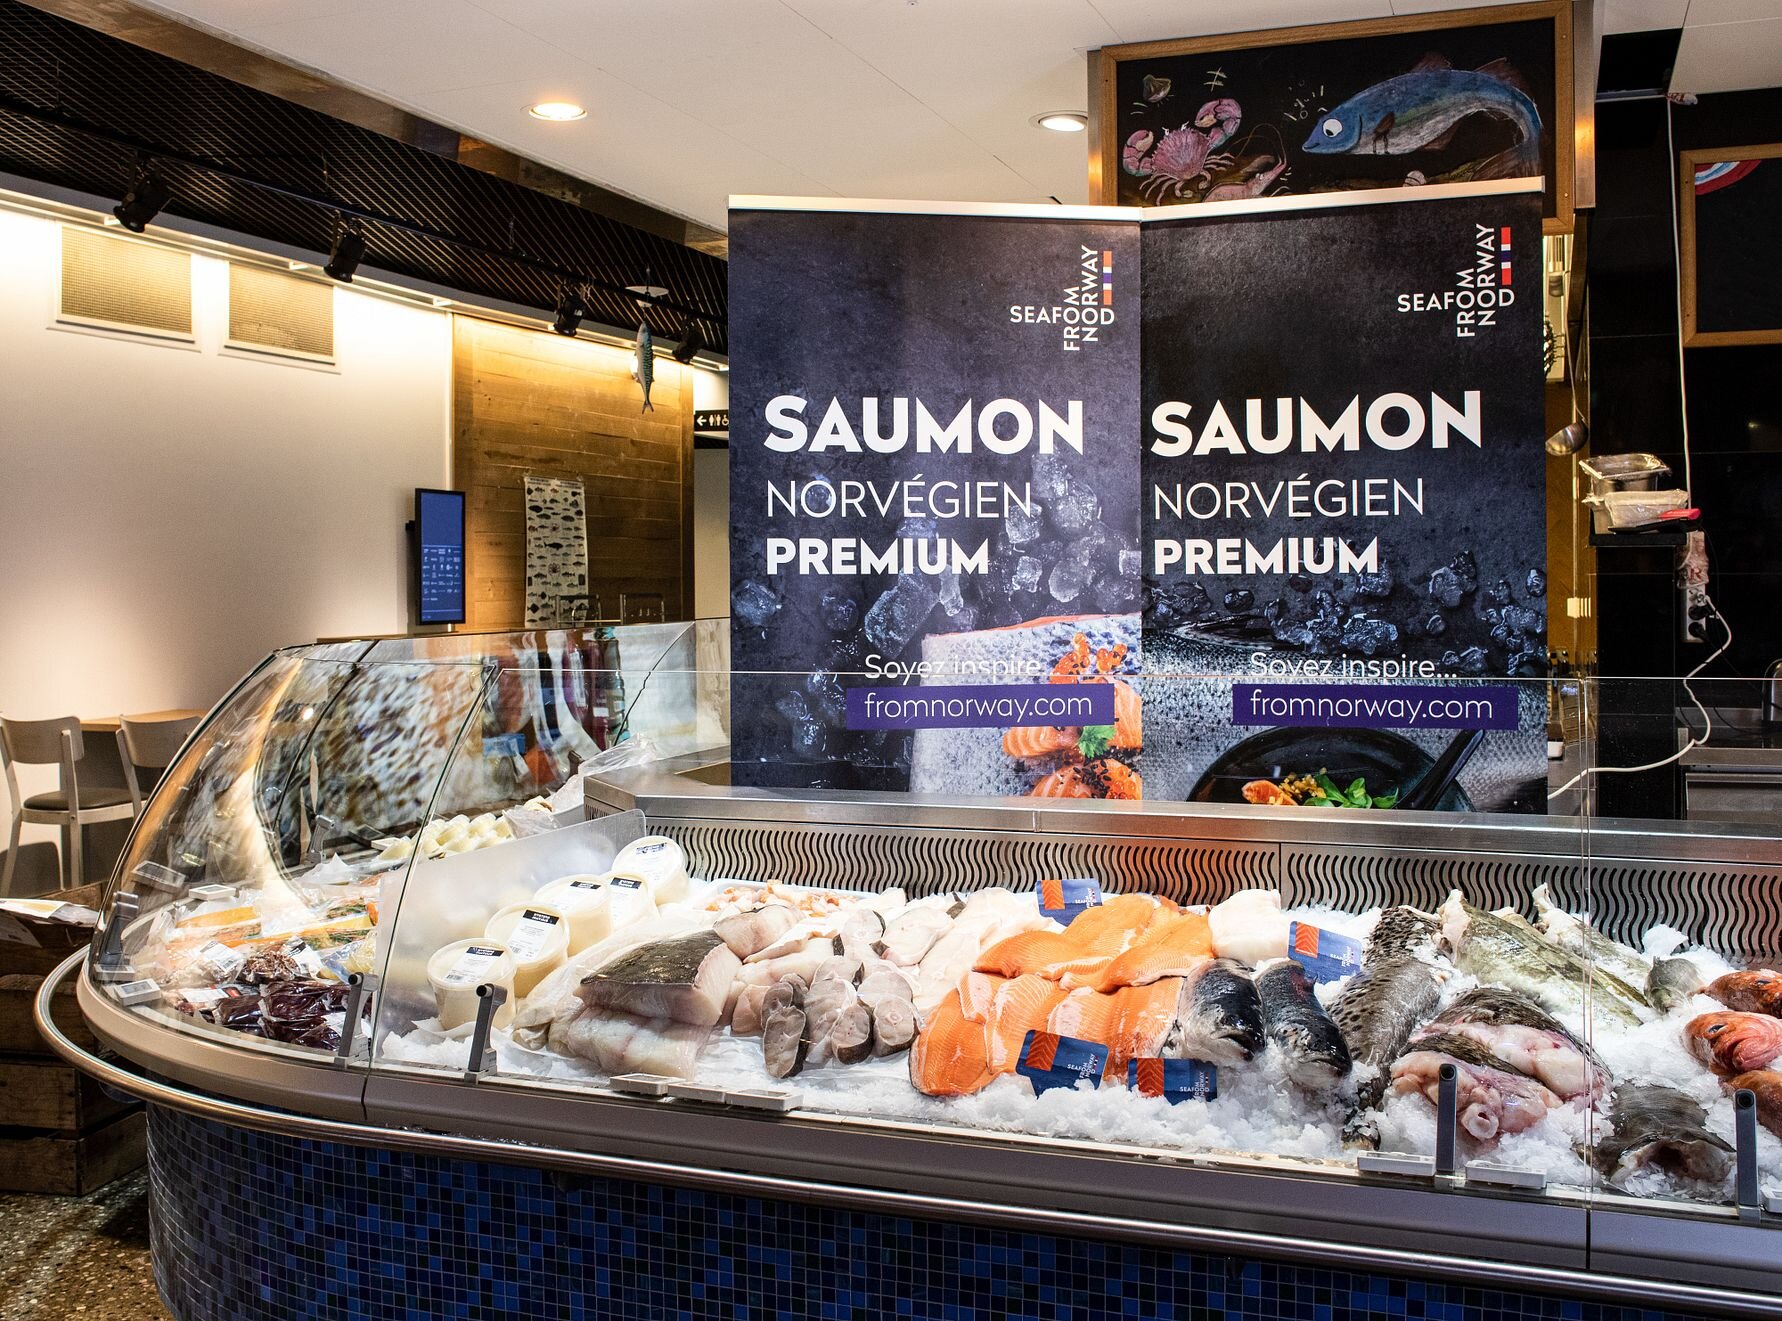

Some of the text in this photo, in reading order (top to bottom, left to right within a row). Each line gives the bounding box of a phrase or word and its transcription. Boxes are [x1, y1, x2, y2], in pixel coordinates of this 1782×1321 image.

[1081, 244, 1100, 343] NORWAY
[1476, 223, 1496, 326] NORWAY
[1009, 304, 1115, 325] SEAFOOD
[1063, 285, 1081, 351] FROM
[1397, 288, 1515, 313] SEAFOOD
[1456, 268, 1476, 338] FROM
[763, 394, 1085, 455] SAUMON
[1150, 390, 1482, 457] SAUMON
[766, 473, 1031, 518] NORVÉGIEN
[1154, 473, 1424, 519] NORVÉGIEN
[766, 537, 989, 575] PREMIUM
[1154, 536, 1379, 575] PREMIUM
[864, 654, 945, 686] Soyez
[864, 692, 1092, 723] fromnorway.com
[1250, 689, 1494, 724] fromnorway.com
[1067, 1063, 1096, 1074] SEAFOOD
